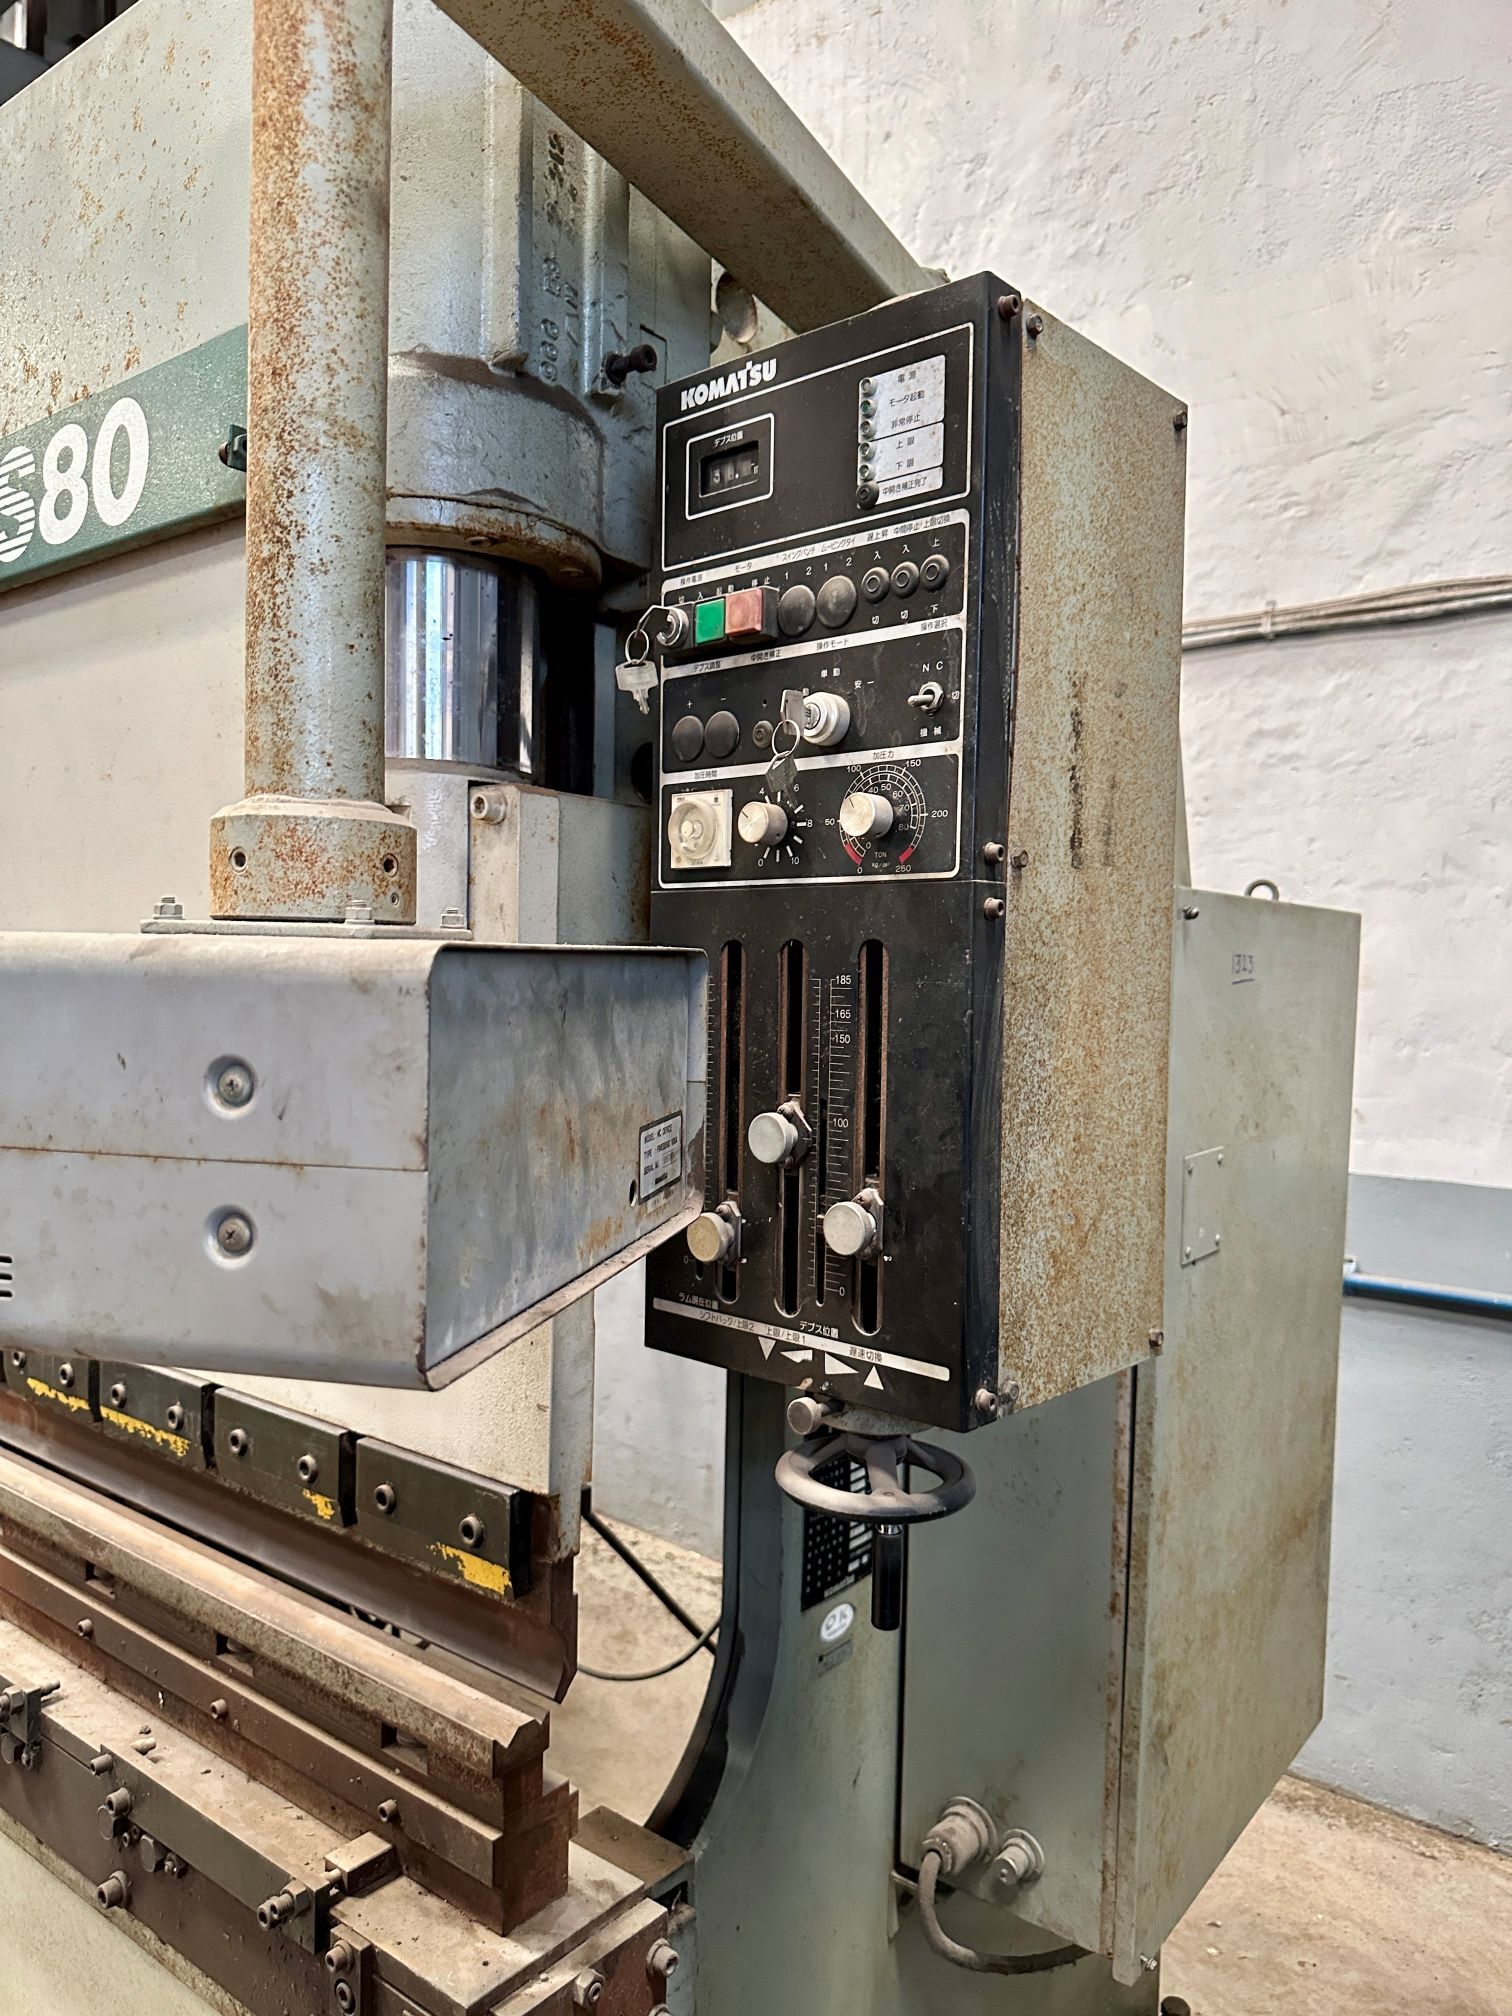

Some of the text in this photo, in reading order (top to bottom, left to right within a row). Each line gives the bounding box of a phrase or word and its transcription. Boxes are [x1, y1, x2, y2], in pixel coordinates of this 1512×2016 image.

[681, 358, 777, 411] KOMATSU
[889, 390, 925, 407] モータ起動
[891, 414, 921, 429] 非常停止
[932, 538, 940, 548] 上
[845, 557, 852, 566] 2
[735, 562, 752, 573] モータ
[805, 567, 812, 575] 2
[823, 562, 828, 571] 1
[931, 604, 939, 614] 下
[817, 639, 849, 650] 操作モード
[872, 751, 894, 760] 加圧力
[906, 759, 921, 768] 150
[847, 765, 862, 773] 100
[759, 787, 765, 795] 4
[899, 804, 910, 812] 70
[931, 810, 949, 818] 200
[807, 819, 812, 827] 8
[758, 859, 764, 867] 0
[791, 857, 800, 865] 10
[857, 867, 863, 875] 0
[895, 865, 912, 873] 250
[835, 975, 851, 985] 185
[835, 1009, 851, 1019] 165
[834, 1034, 851, 1044] 150
[832, 1118, 849, 1128] 100
[839, 1286, 846, 1296] 0
